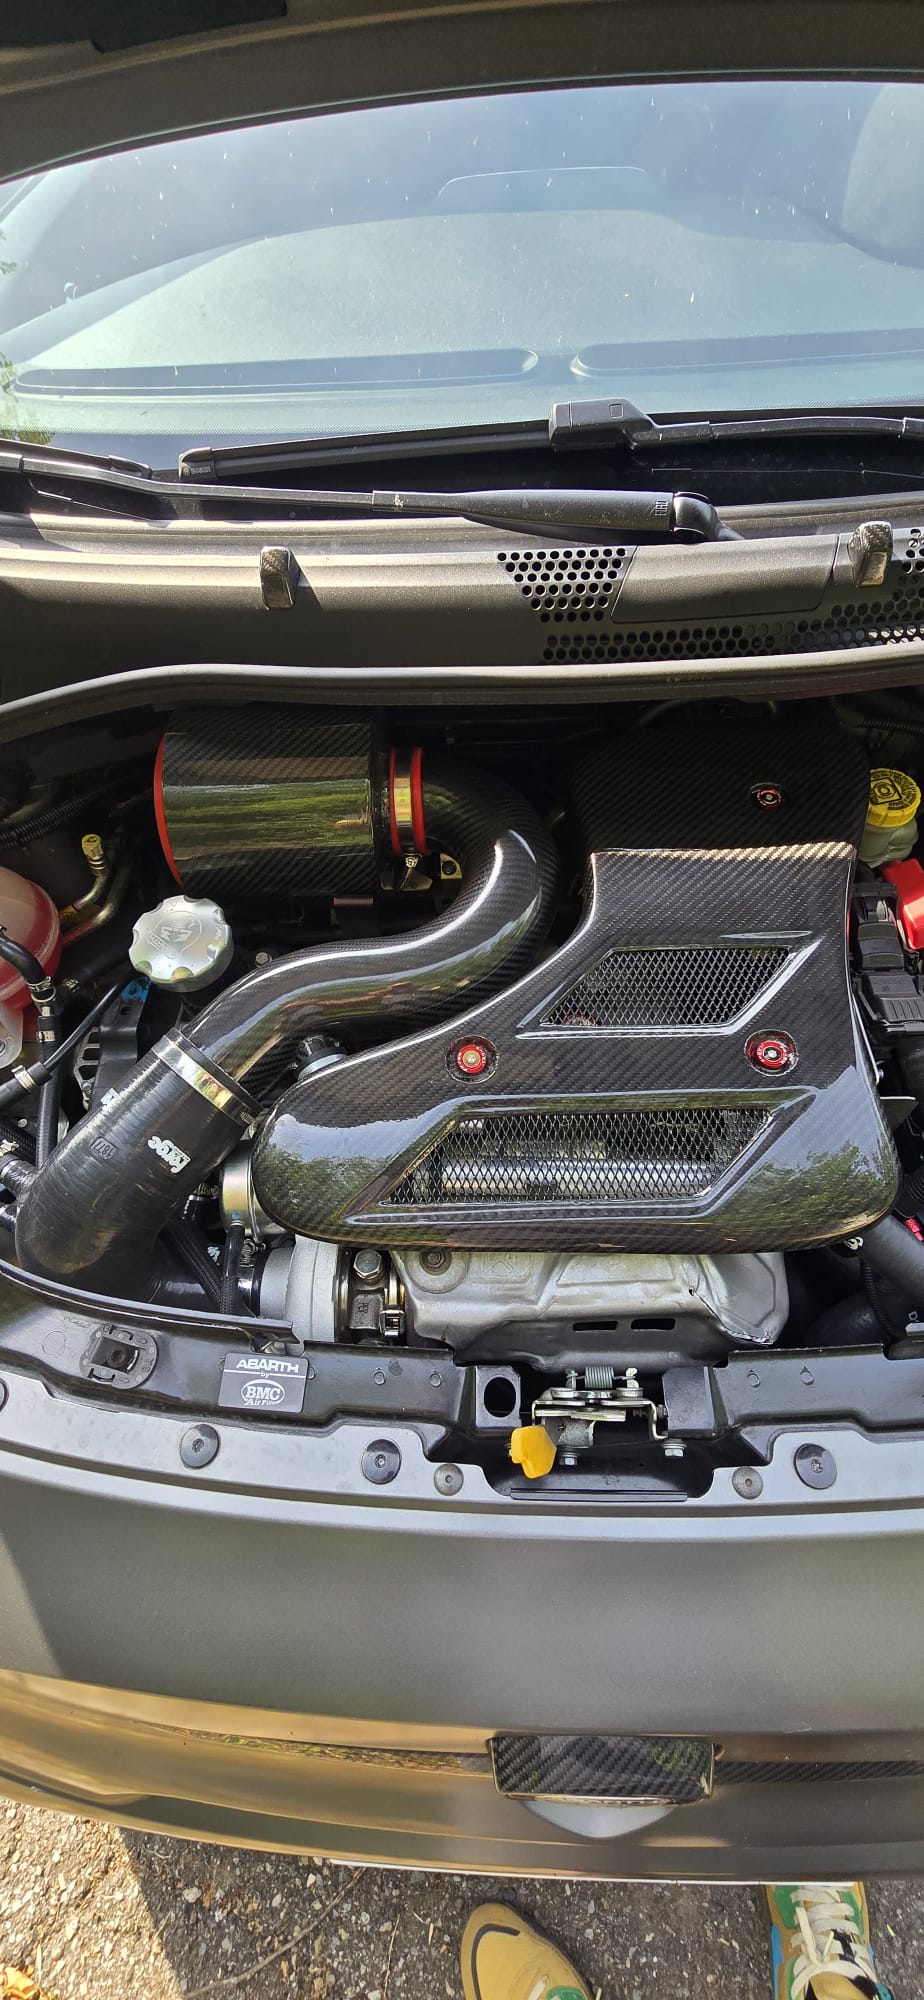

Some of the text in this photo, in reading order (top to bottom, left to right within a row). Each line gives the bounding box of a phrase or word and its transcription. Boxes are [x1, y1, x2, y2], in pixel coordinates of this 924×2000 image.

[93, 1140, 114, 1157] 1877
[235, 1359, 299, 1373] ABARTH
[260, 1370, 270, 1378] by
[245, 1385, 281, 1401] BMC
